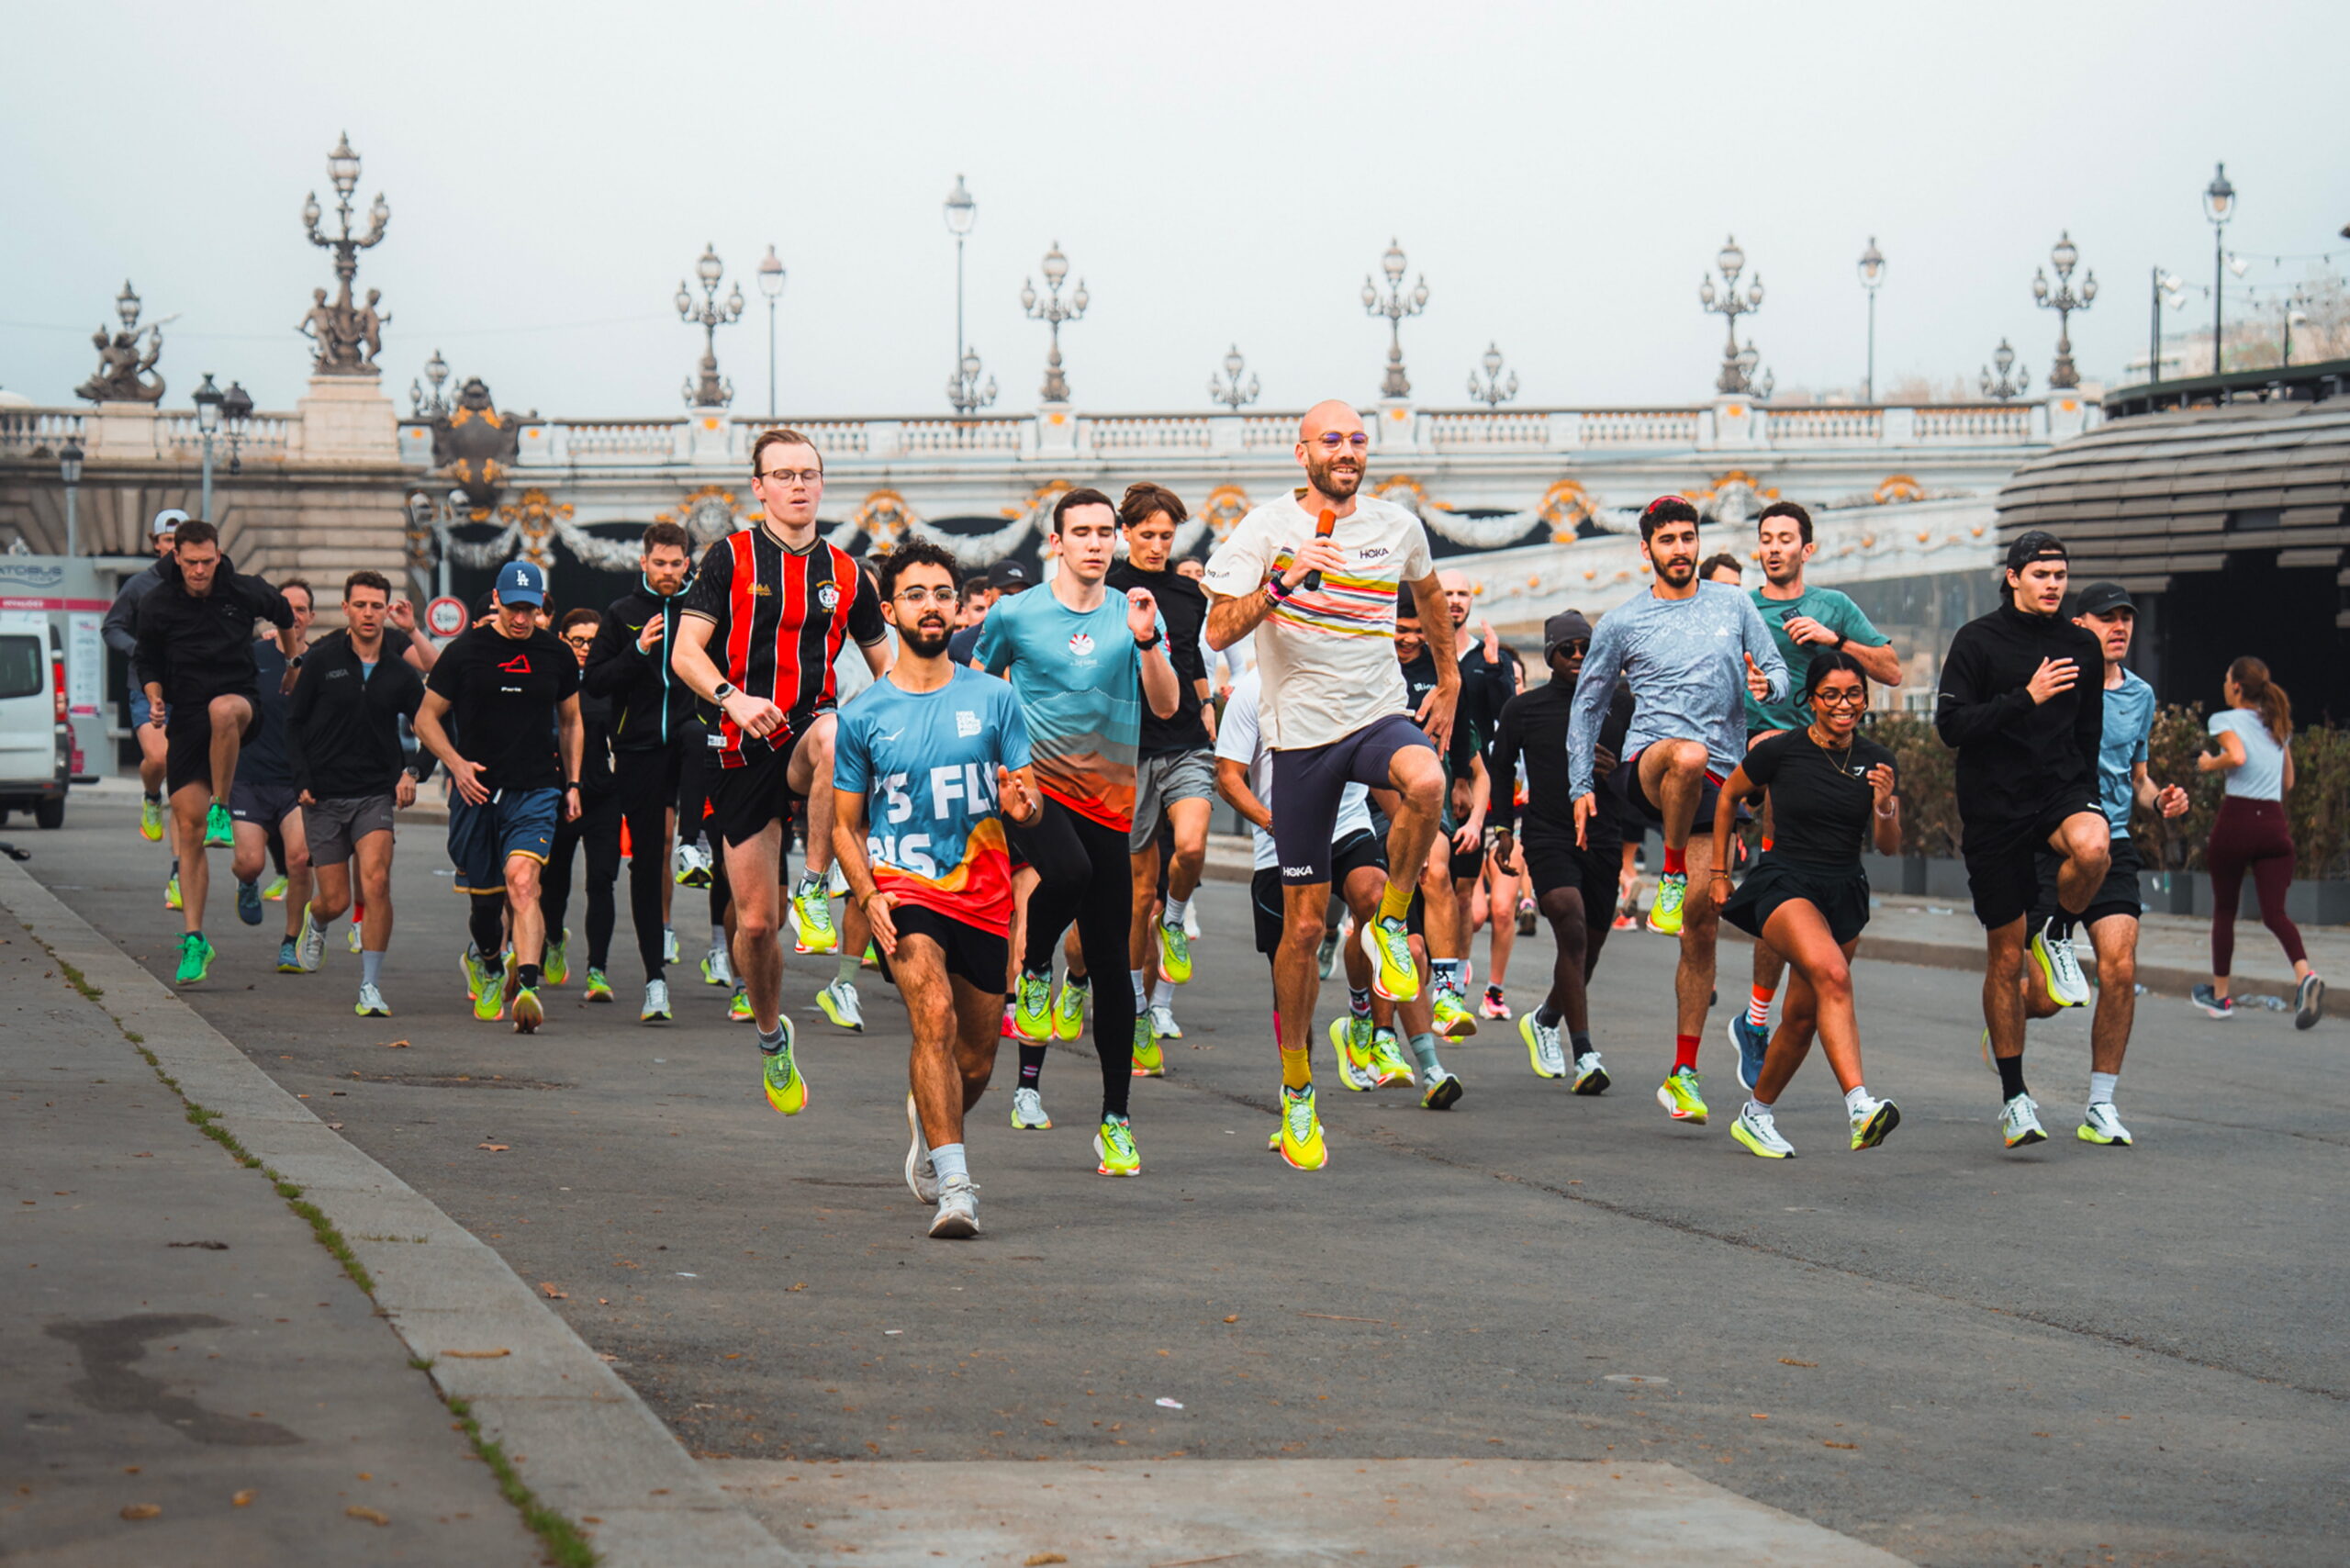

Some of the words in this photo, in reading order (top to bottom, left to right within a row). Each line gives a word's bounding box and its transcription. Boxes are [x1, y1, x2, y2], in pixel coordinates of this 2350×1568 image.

[1360, 548, 1389, 559] HOKA
[516, 569, 530, 587] LA
[867, 833, 936, 879] RIS
[1282, 865, 1314, 878] HOKA
